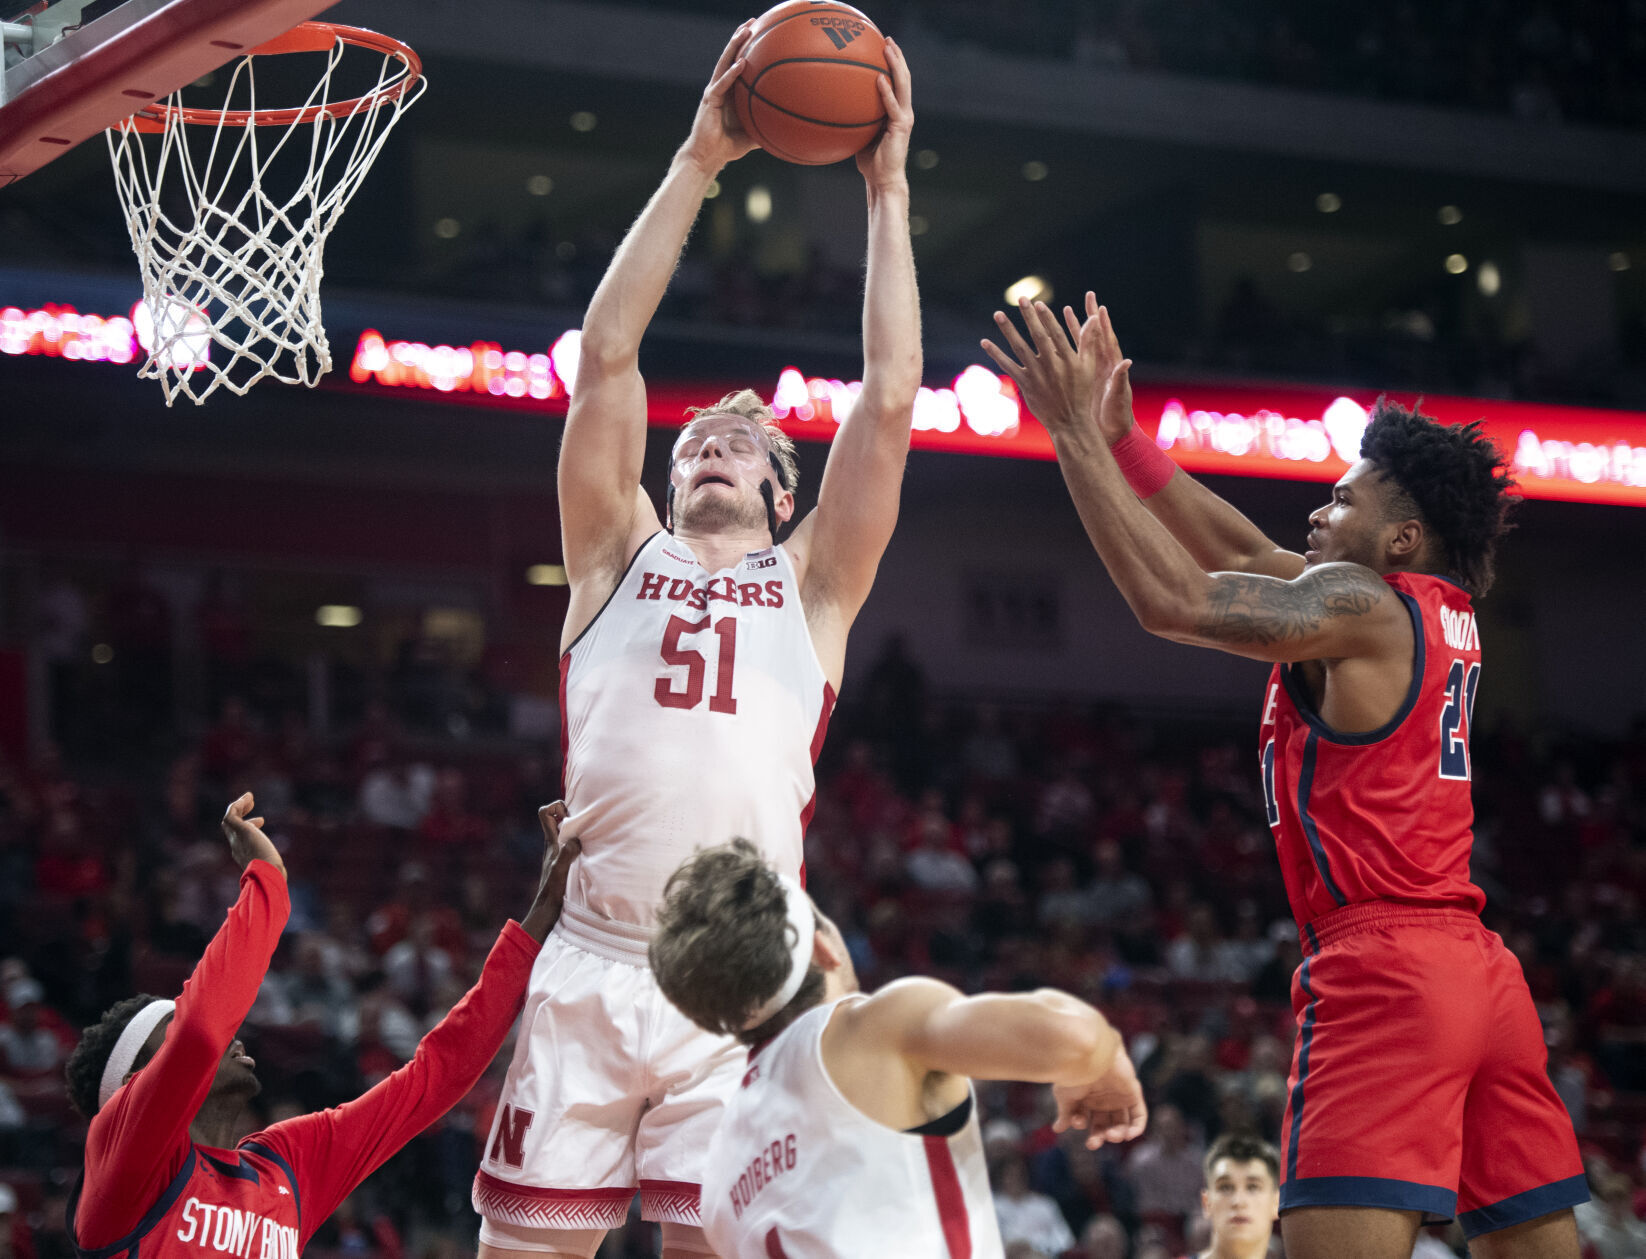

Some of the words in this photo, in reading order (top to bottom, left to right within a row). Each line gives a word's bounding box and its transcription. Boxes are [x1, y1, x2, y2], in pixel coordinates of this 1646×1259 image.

[661, 548, 694, 565] GRADUATE
[636, 572, 784, 611] HUSKERS
[654, 614, 737, 715] 51
[489, 1101, 536, 1169] N
[729, 1132, 797, 1221] HOIBERG
[177, 1196, 262, 1259] STONY
